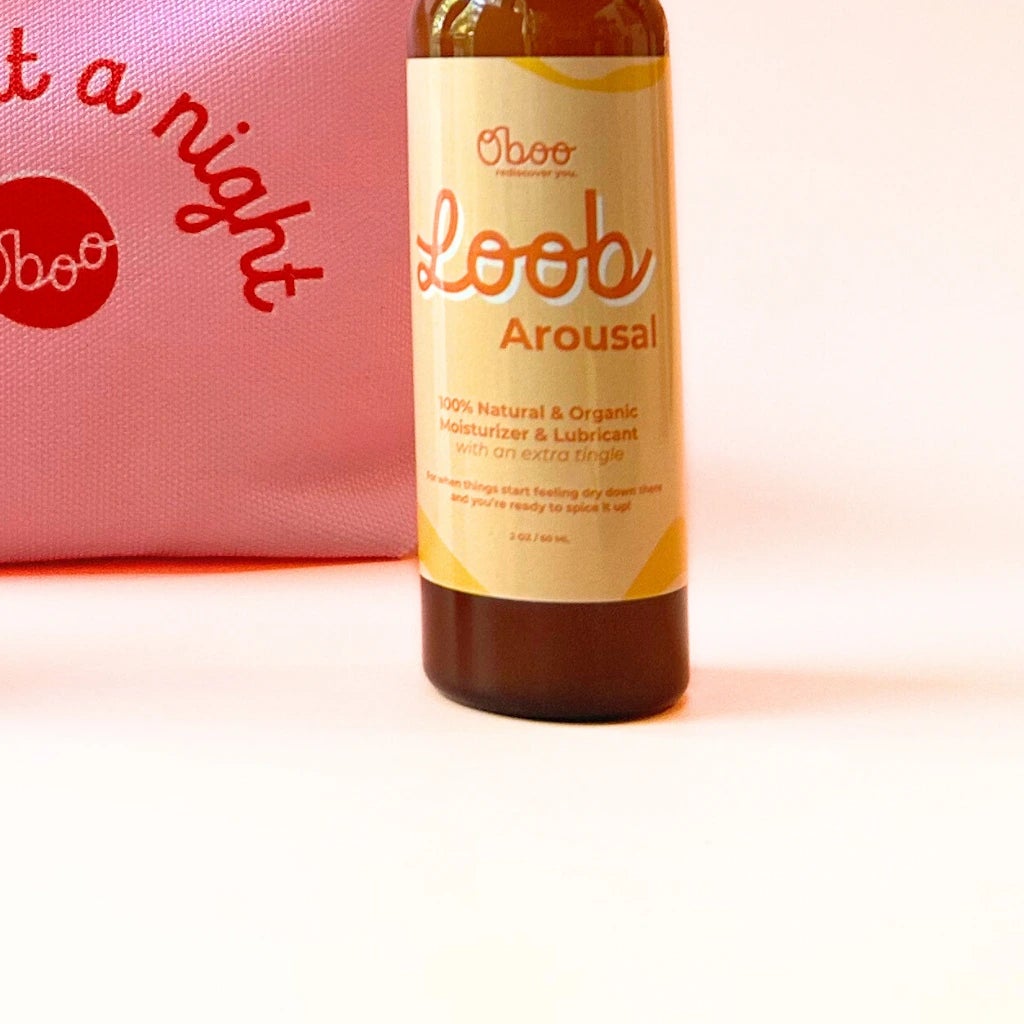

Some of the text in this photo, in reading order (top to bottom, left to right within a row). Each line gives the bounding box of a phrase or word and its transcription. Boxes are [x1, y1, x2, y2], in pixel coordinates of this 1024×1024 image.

[477, 125, 576, 166] Oboo
[76, 58, 144, 115] a
[151, 91, 325, 313] night
[496, 168, 553, 178] rediscover
[416, 188, 655, 302] Loob
[499, 314, 657, 352] Arousal
[438, 395, 638, 423] 100% Natural & Organic
[439, 417, 638, 442] Moisturizer & Lubricant
[456, 442, 624, 466] with an extra tingle
[463, 480, 498, 495] things
[501, 486, 530, 496] start
[533, 486, 579, 500] feeling
[581, 487, 603, 500] dry
[605, 486, 636, 497] down
[451, 493, 469, 504] and
[509, 501, 546, 514] ready
[548, 502, 563, 513] to
[566, 503, 599, 516] spice
